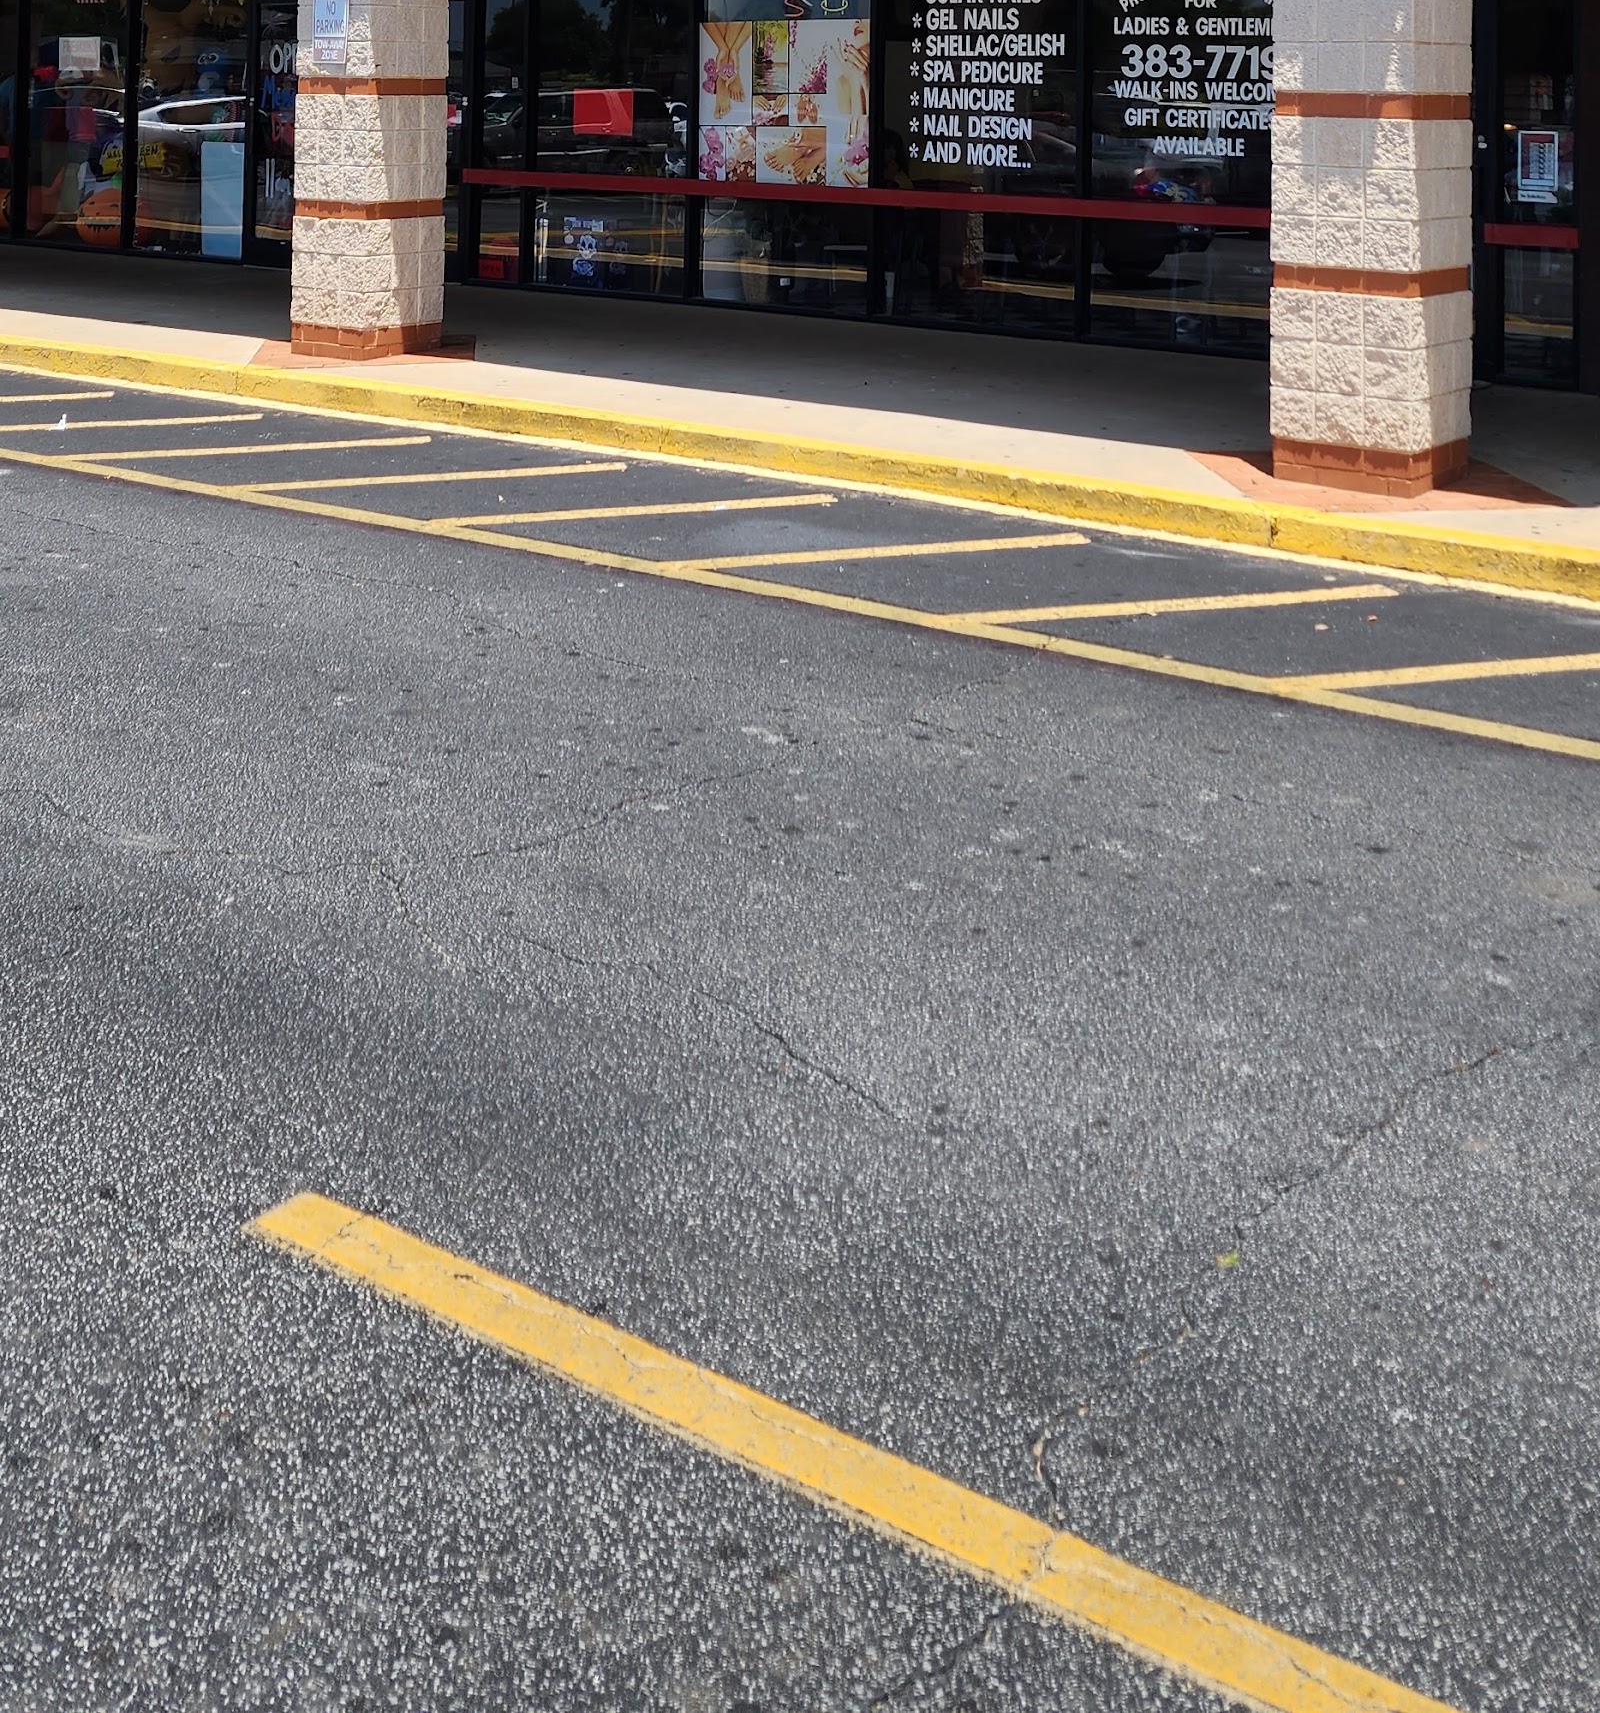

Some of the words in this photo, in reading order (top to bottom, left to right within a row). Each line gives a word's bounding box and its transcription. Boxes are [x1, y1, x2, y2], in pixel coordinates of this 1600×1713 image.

[326, 0, 337, 16] NO
[926, 8, 958, 31] GEL
[963, 7, 1020, 30] NAILS
[315, 19, 345, 34] PARKING
[1113, 16, 1170, 36] LADIES
[1175, 16, 1189, 36] &
[1195, 17, 1272, 37] GENTLEM
[321, 50, 338, 60] ZONE
[925, 33, 1065, 57] SHELLAC/GELISH
[922, 60, 955, 83] SPA
[961, 60, 1044, 84] PEDICURE
[922, 87, 1015, 112] MANICURE
[1113, 80, 1199, 100] WALK-INS
[923, 114, 962, 137] NAIL
[968, 116, 1032, 141] DESIGN
[1124, 108, 1160, 127] GIFT
[922, 141, 961, 164] AND
[966, 143, 1032, 169] MORE...
[1152, 135, 1246, 157] AVAILABLE
